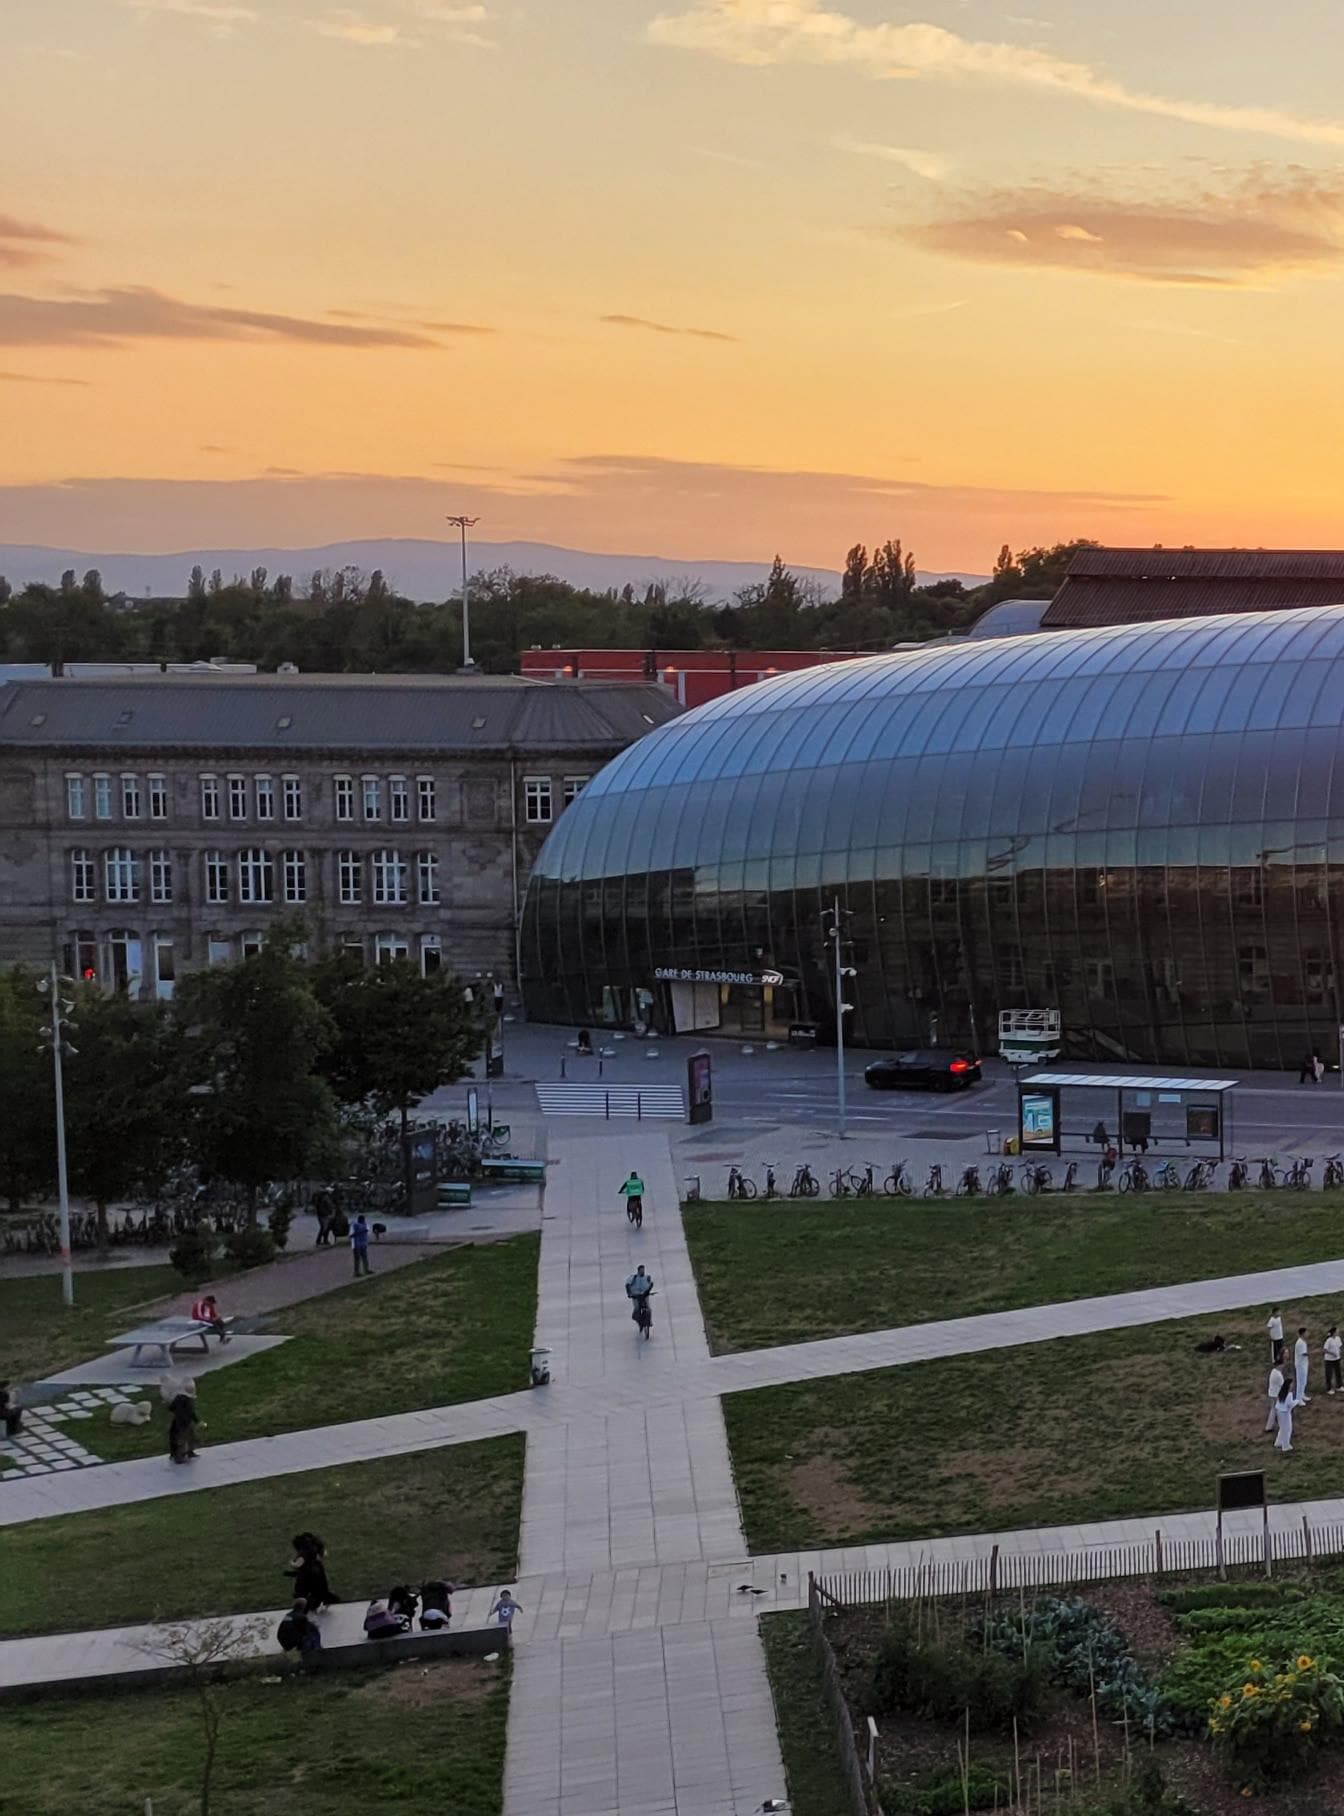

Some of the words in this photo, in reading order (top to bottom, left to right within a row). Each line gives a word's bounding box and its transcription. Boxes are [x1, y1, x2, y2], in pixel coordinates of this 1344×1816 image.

[655, 967, 678, 978] GARE
[681, 969, 692, 979] DE
[695, 970, 753, 983] STRASBOURG
